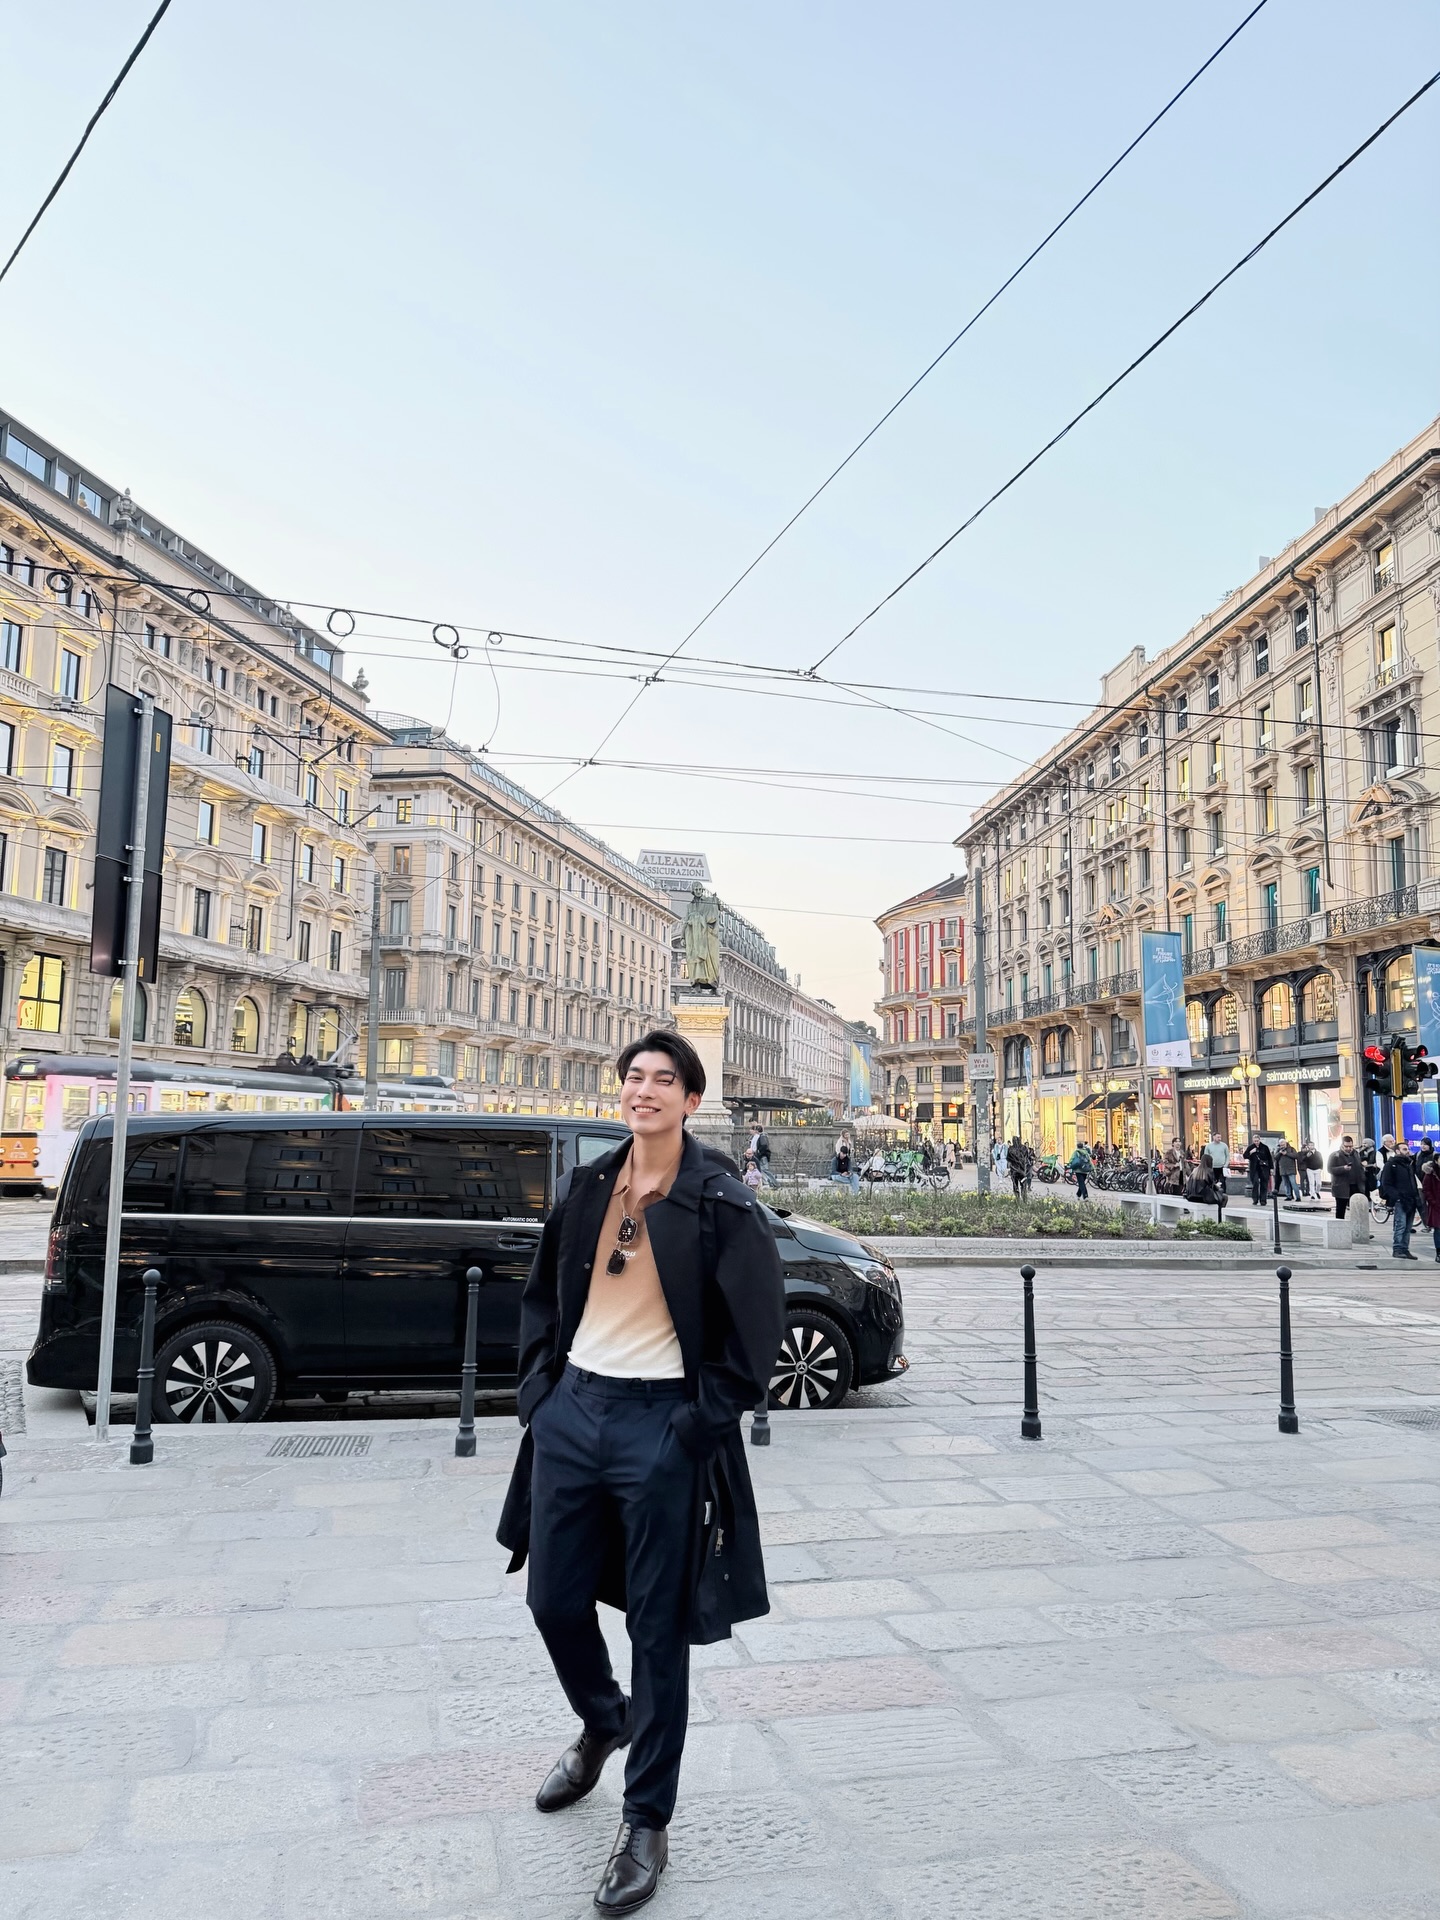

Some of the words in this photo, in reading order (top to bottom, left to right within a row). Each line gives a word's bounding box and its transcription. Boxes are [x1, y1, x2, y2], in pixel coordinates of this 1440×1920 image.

[641, 855, 705, 868] ALLEANZA
[641, 866, 705, 877] ASSICURAZIONI
[1155, 1082, 1172, 1096] M
